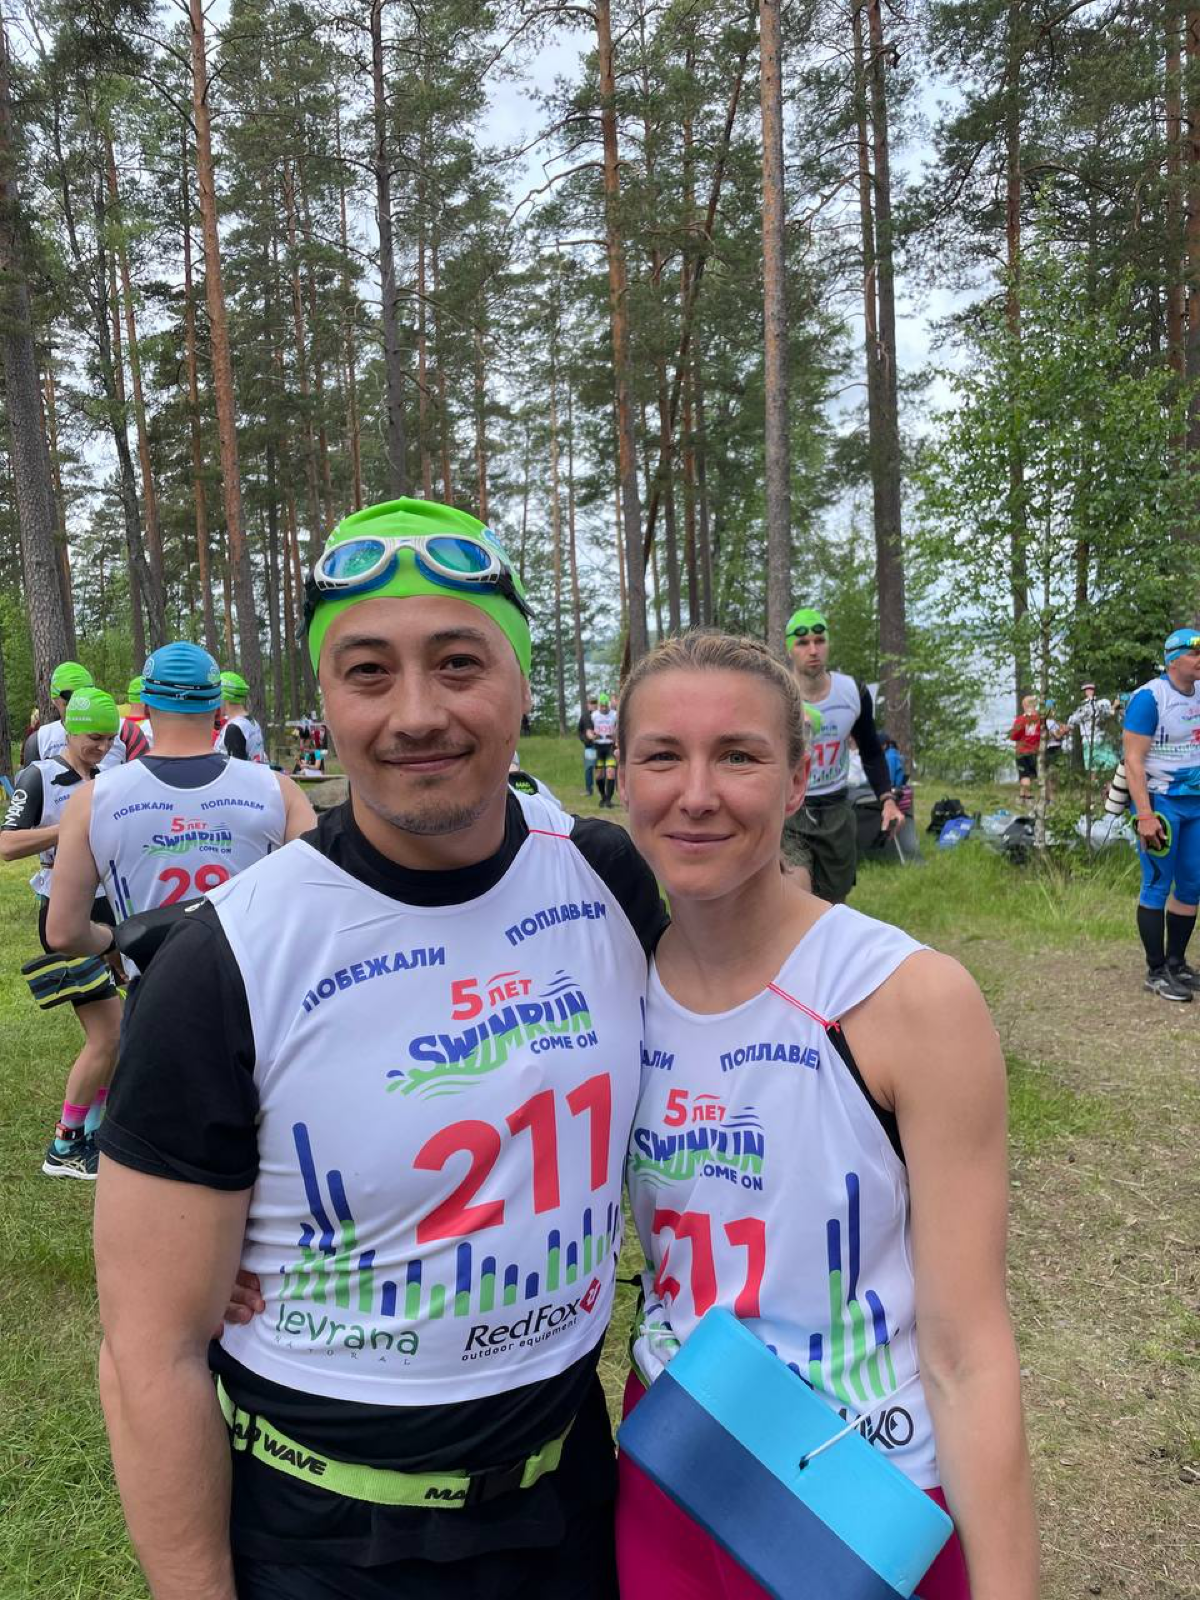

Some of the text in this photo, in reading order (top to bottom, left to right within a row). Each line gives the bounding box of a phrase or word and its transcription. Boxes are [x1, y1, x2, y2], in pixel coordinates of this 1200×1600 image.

[4, 788, 28, 827] MAKO
[113, 801, 174, 820] ПОБЕЖАЛИ
[201, 798, 265, 811] ПОПЛАВАЕМ
[151, 831, 233, 853] SWIMRUN
[171, 817, 185, 832] 5
[301, 946, 446, 1012] ПОБЕЖАЛИ
[451, 978, 532, 1021] 5 ЛЕТ
[408, 990, 594, 1071] SWIMRUN
[530, 1030, 598, 1055] COME ON
[663, 1088, 726, 1127] 5 ЛЕТ
[412, 1072, 612, 1245] 211
[700, 1164, 763, 1192] OME ON
[275, 1303, 420, 1356] levrana
[462, 1318, 577, 1361] outdoor equipment
[263, 1433, 328, 1476] WAVE
